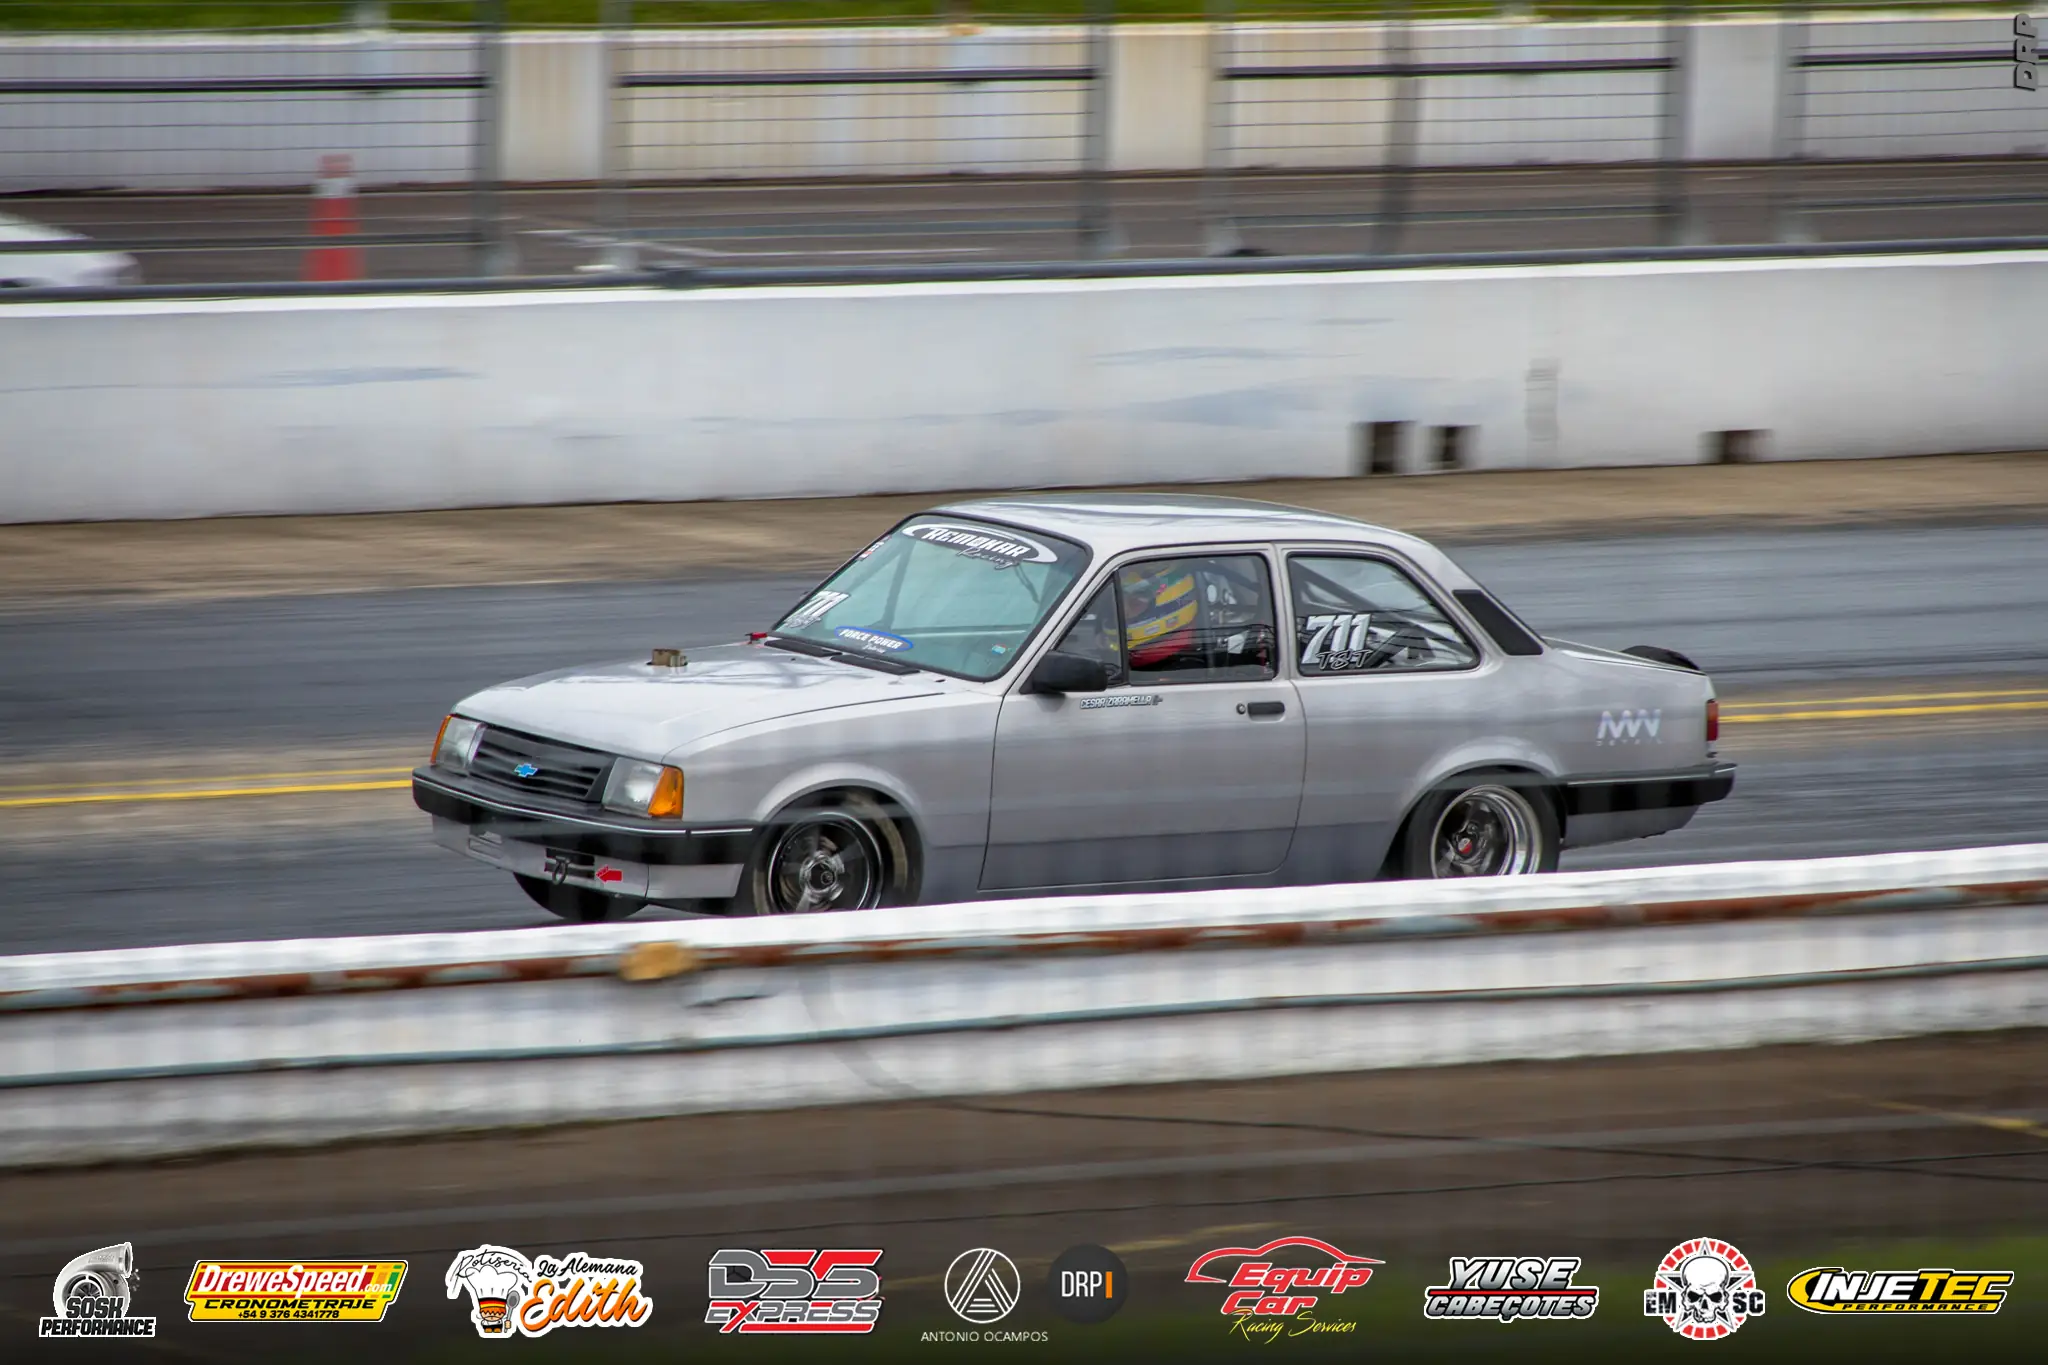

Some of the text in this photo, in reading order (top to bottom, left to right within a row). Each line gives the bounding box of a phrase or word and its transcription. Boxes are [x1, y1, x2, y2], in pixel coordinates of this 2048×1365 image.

[838, 628, 872, 642] FORCE
[868, 635, 903, 650] POWER
[1301, 613, 1371, 664] 711
